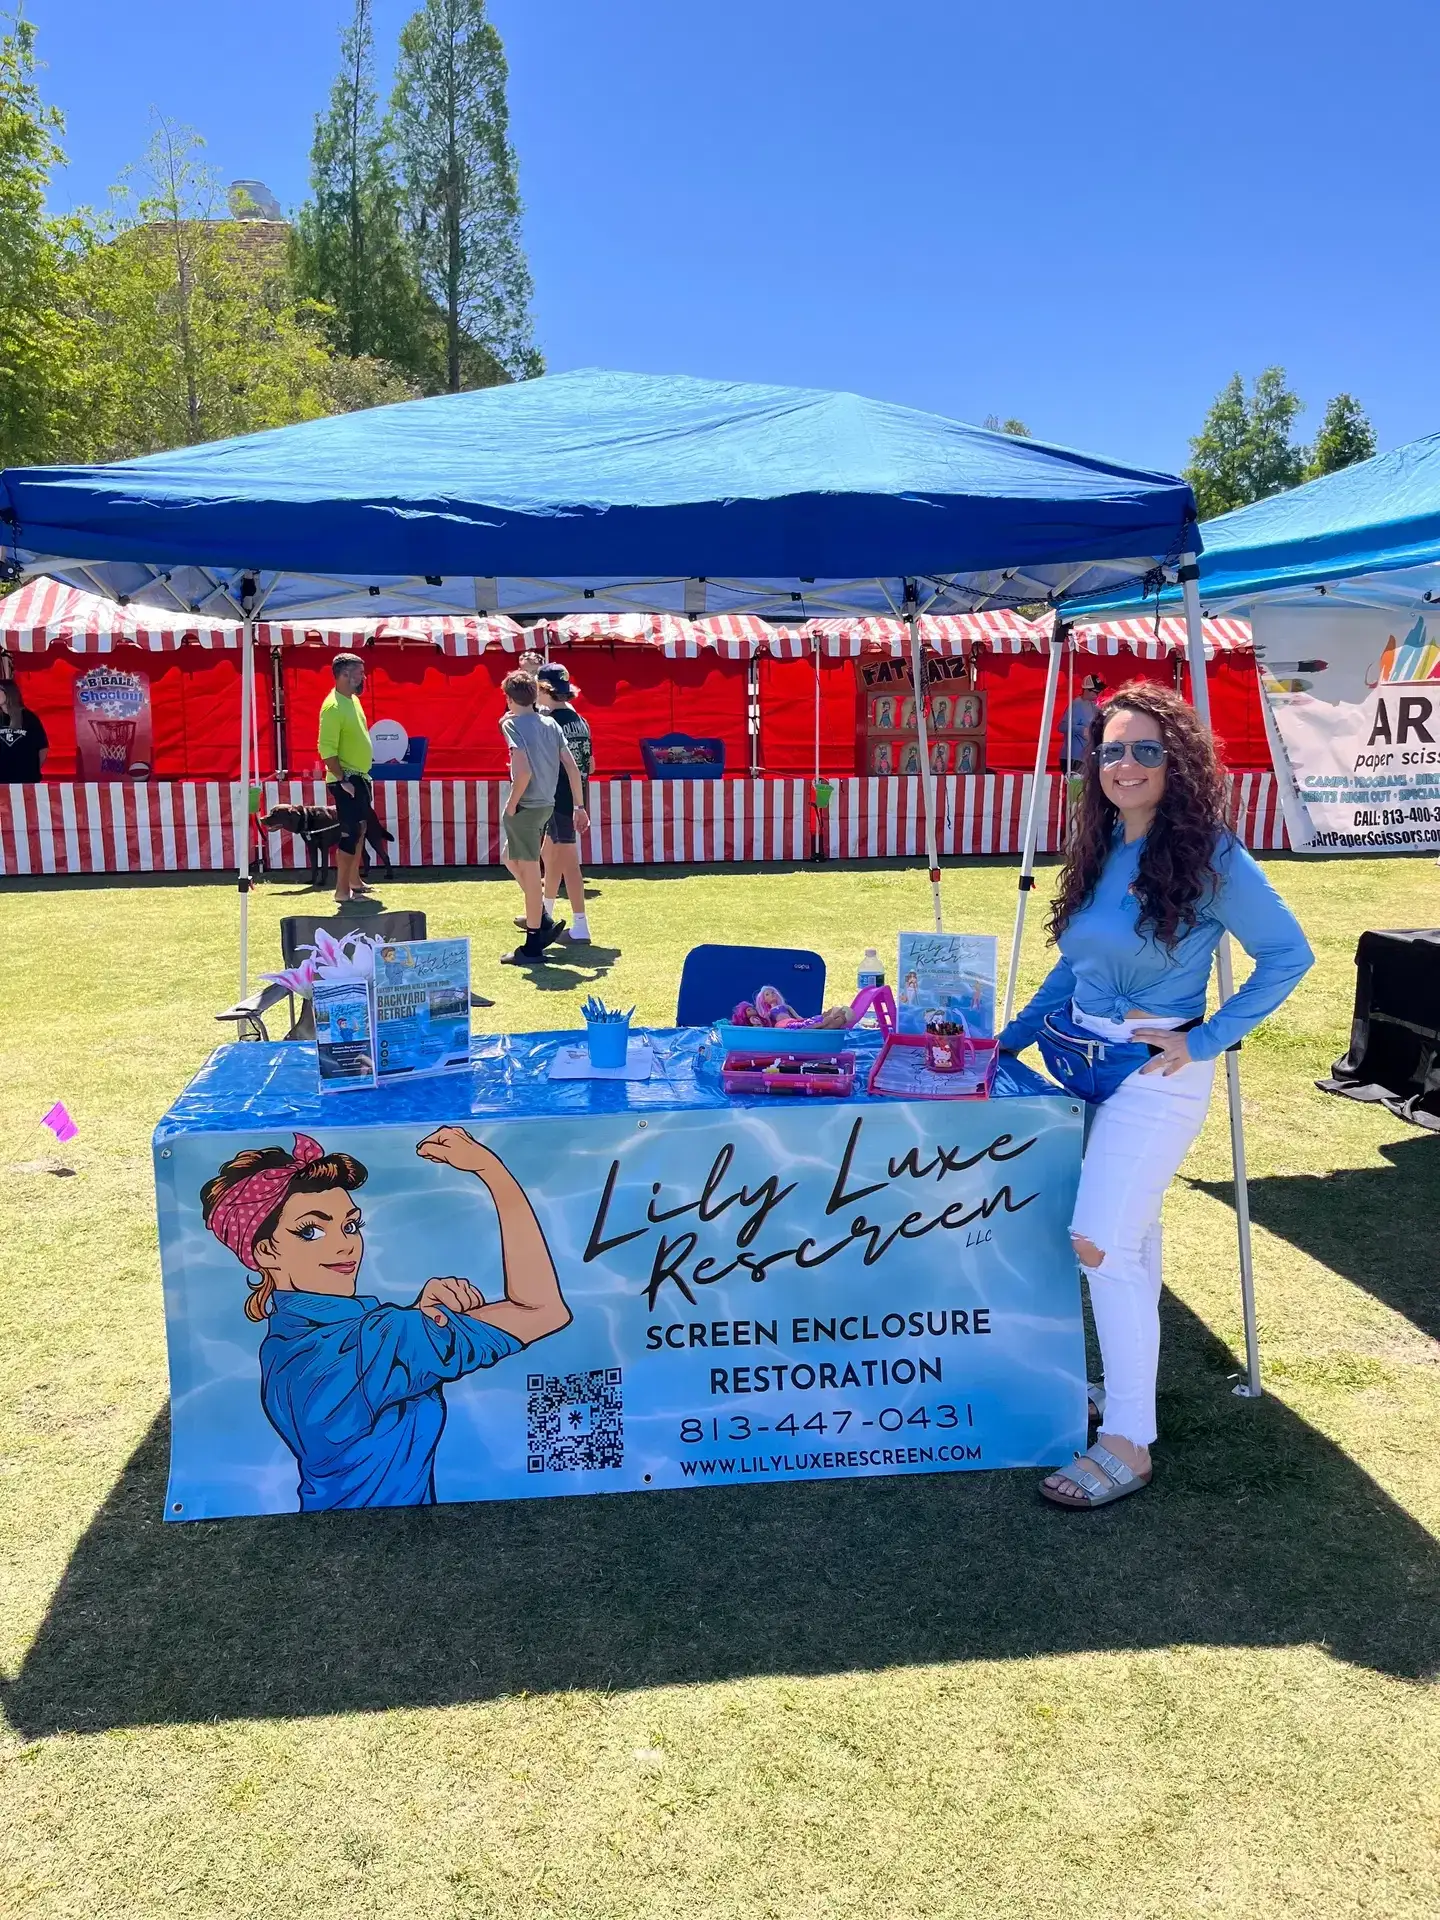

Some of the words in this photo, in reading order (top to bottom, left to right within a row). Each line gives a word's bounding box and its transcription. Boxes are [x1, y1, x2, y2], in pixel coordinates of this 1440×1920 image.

[861, 657, 908, 687] FAT
[88, 676, 135, 688] B'BALL
[79, 689, 143, 703] Shootout
[1354, 753, 1394, 772] paper
[1354, 810, 1381, 827] CALL:
[1303, 829, 1440, 848] yArtPaperScissors.co
[377, 991, 426, 1008] BACKYARD
[377, 1005, 417, 1021] RETREAT
[583, 1143, 799, 1263] Lily
[825, 1117, 1038, 1215] Luxe
[641, 1186, 1042, 1312] Rescreen
[966, 1230, 993, 1249] LLC
[645, 1319, 779, 1350] SCREEN
[792, 1308, 991, 1343] ENCLOSURE
[710, 1357, 943, 1395] RESTORATION
[680, 1404, 976, 1444] 813-447-0431
[680, 1445, 982, 1477] WWW.LILYLUXERESCREEN.COM
